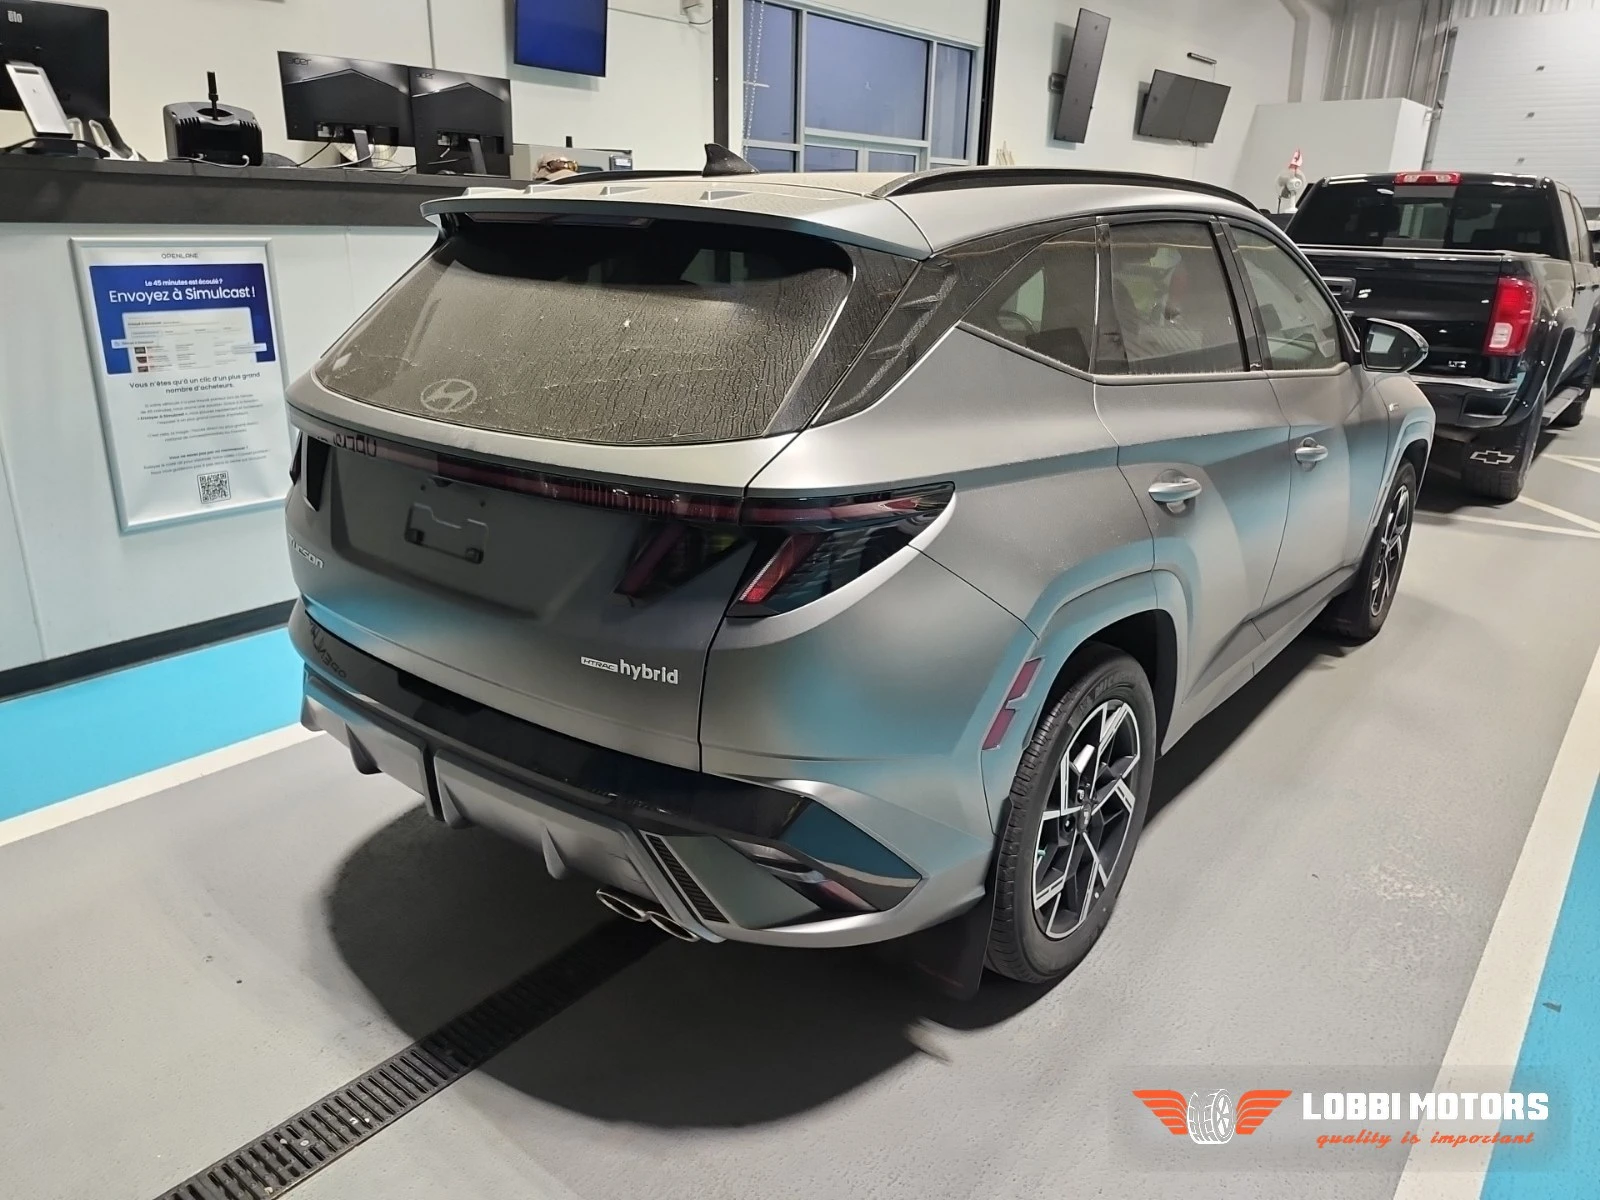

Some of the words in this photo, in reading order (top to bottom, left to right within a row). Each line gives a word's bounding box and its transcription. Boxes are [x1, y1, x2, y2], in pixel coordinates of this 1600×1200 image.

[162, 278, 188, 286] minutes
[109, 290, 170, 305] Envoyez
[172, 287, 183, 301] à
[149, 379, 172, 387] n'êtes
[173, 378, 188, 387] qu'à
[227, 374, 241, 382] plus
[241, 372, 260, 381] grand
[165, 385, 193, 394] nombre
[583, 659, 616, 671] HTRAC
[620, 658, 679, 685] hybrid
